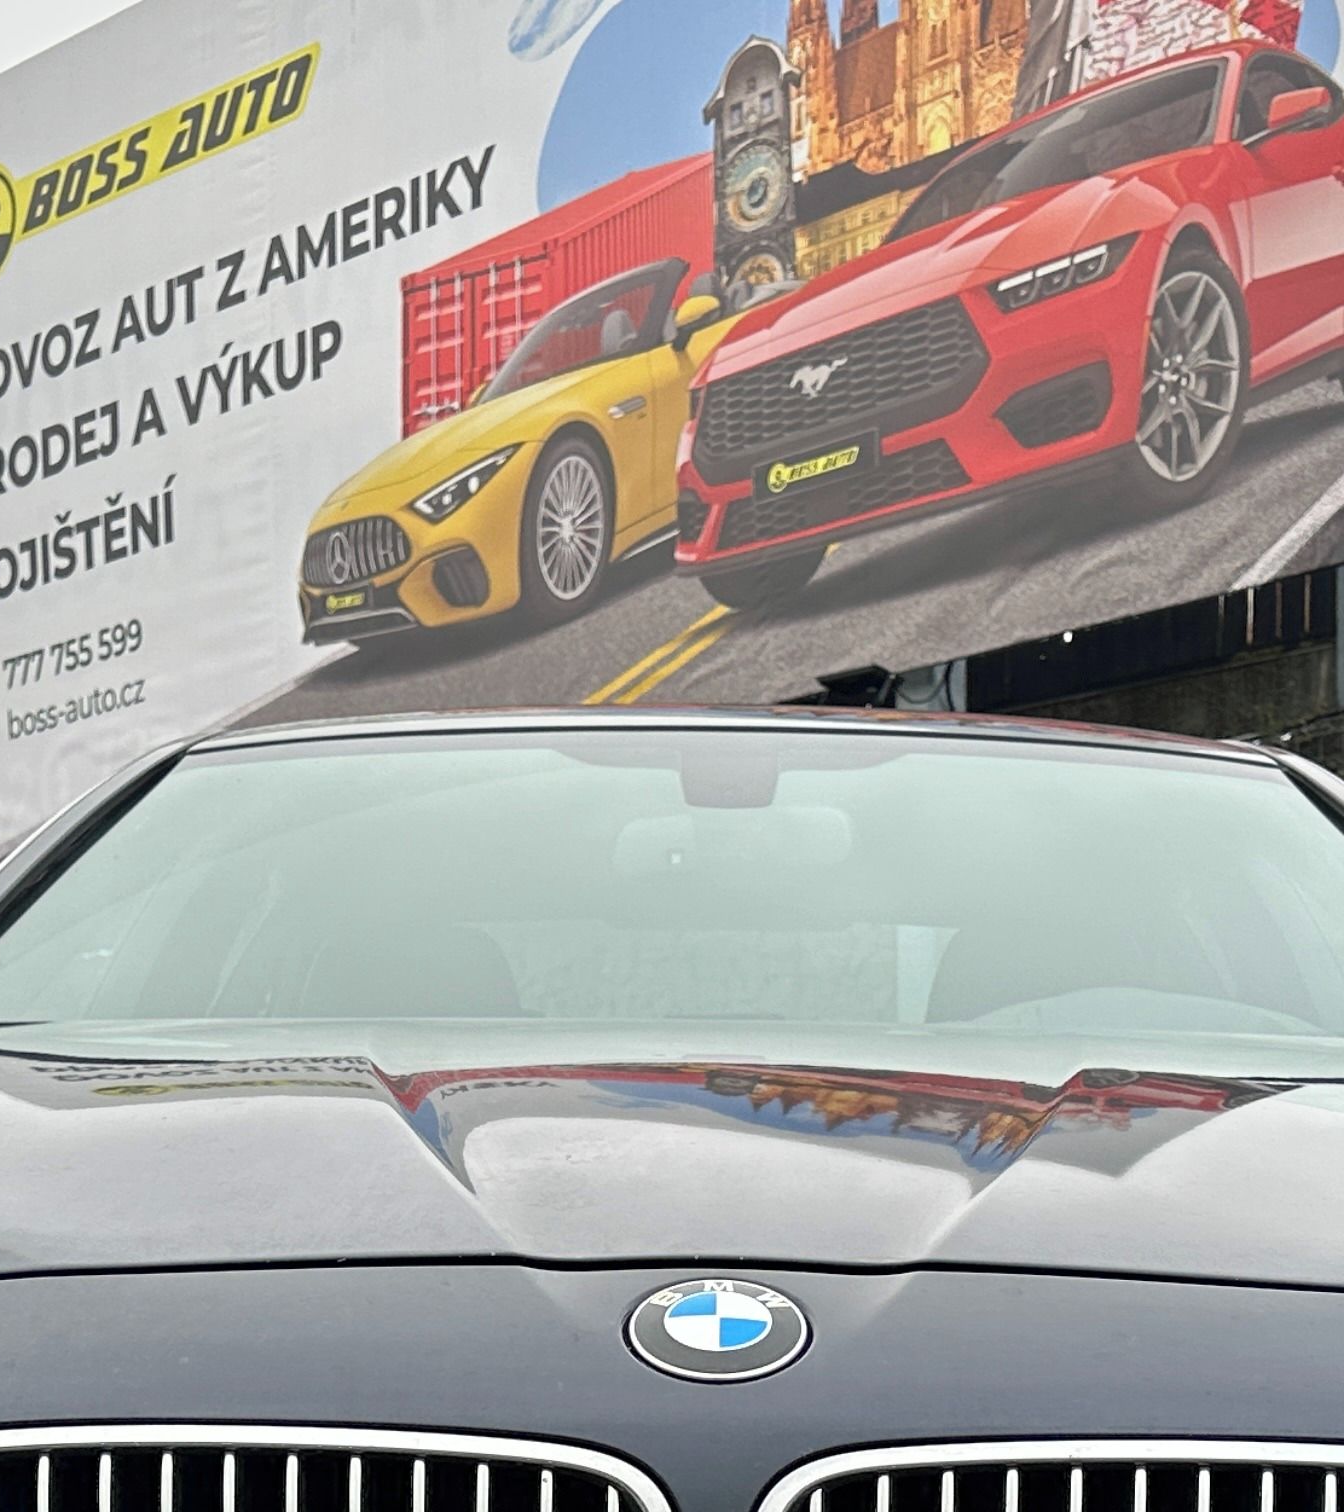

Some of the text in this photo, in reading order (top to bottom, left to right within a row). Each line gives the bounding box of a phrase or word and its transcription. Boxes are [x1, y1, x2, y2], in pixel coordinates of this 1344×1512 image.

[22, 53, 312, 234] BOSS AUTO
[111, 266, 204, 353] AUT
[216, 249, 246, 313] Z
[258, 145, 496, 295] AMERIKY
[132, 387, 165, 448] A
[176, 319, 343, 426] VÝKUP
[2, 619, 143, 690] 777 755 599
[7, 680, 145, 740] boss-auto.cz
[649, 1280, 792, 1308] BMW
